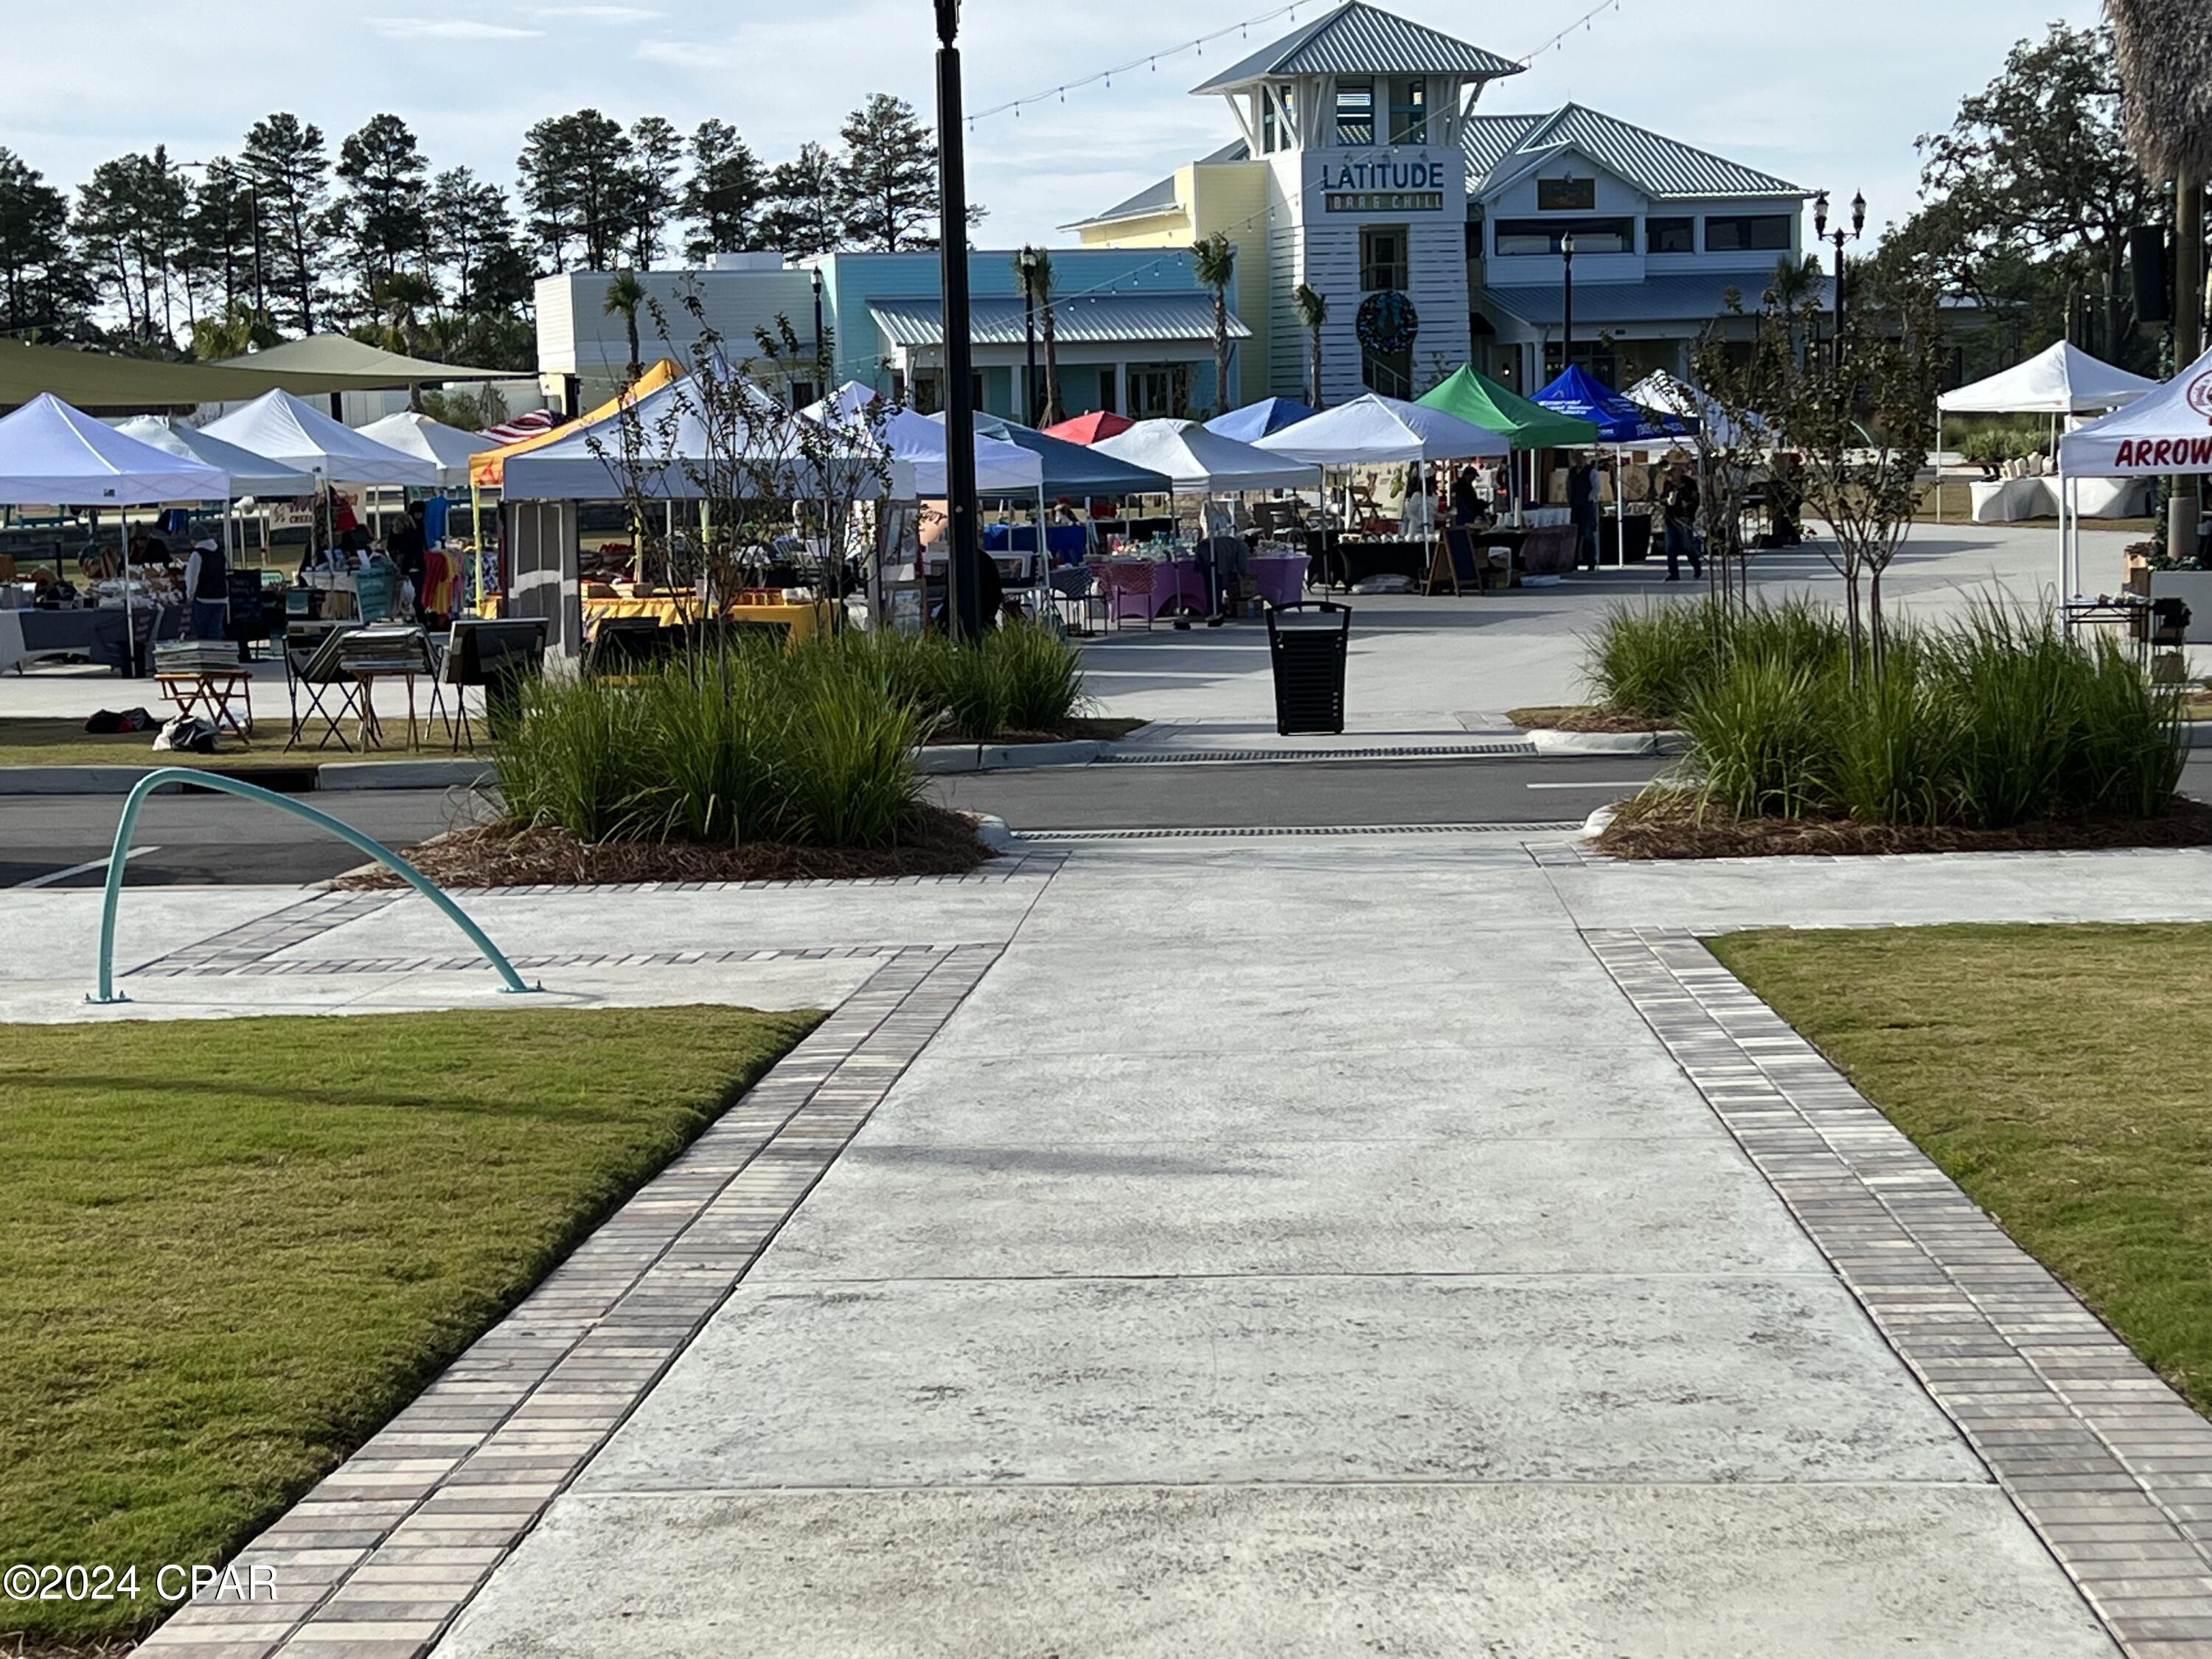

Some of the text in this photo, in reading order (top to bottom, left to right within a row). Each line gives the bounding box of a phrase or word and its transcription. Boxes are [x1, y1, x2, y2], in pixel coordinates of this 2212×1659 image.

[1323, 163, 1444, 189] LATITUDE
[1333, 195, 1366, 209] BAR
[1391, 195, 1442, 209] CHILL
[2114, 437, 2212, 467] ARROW
